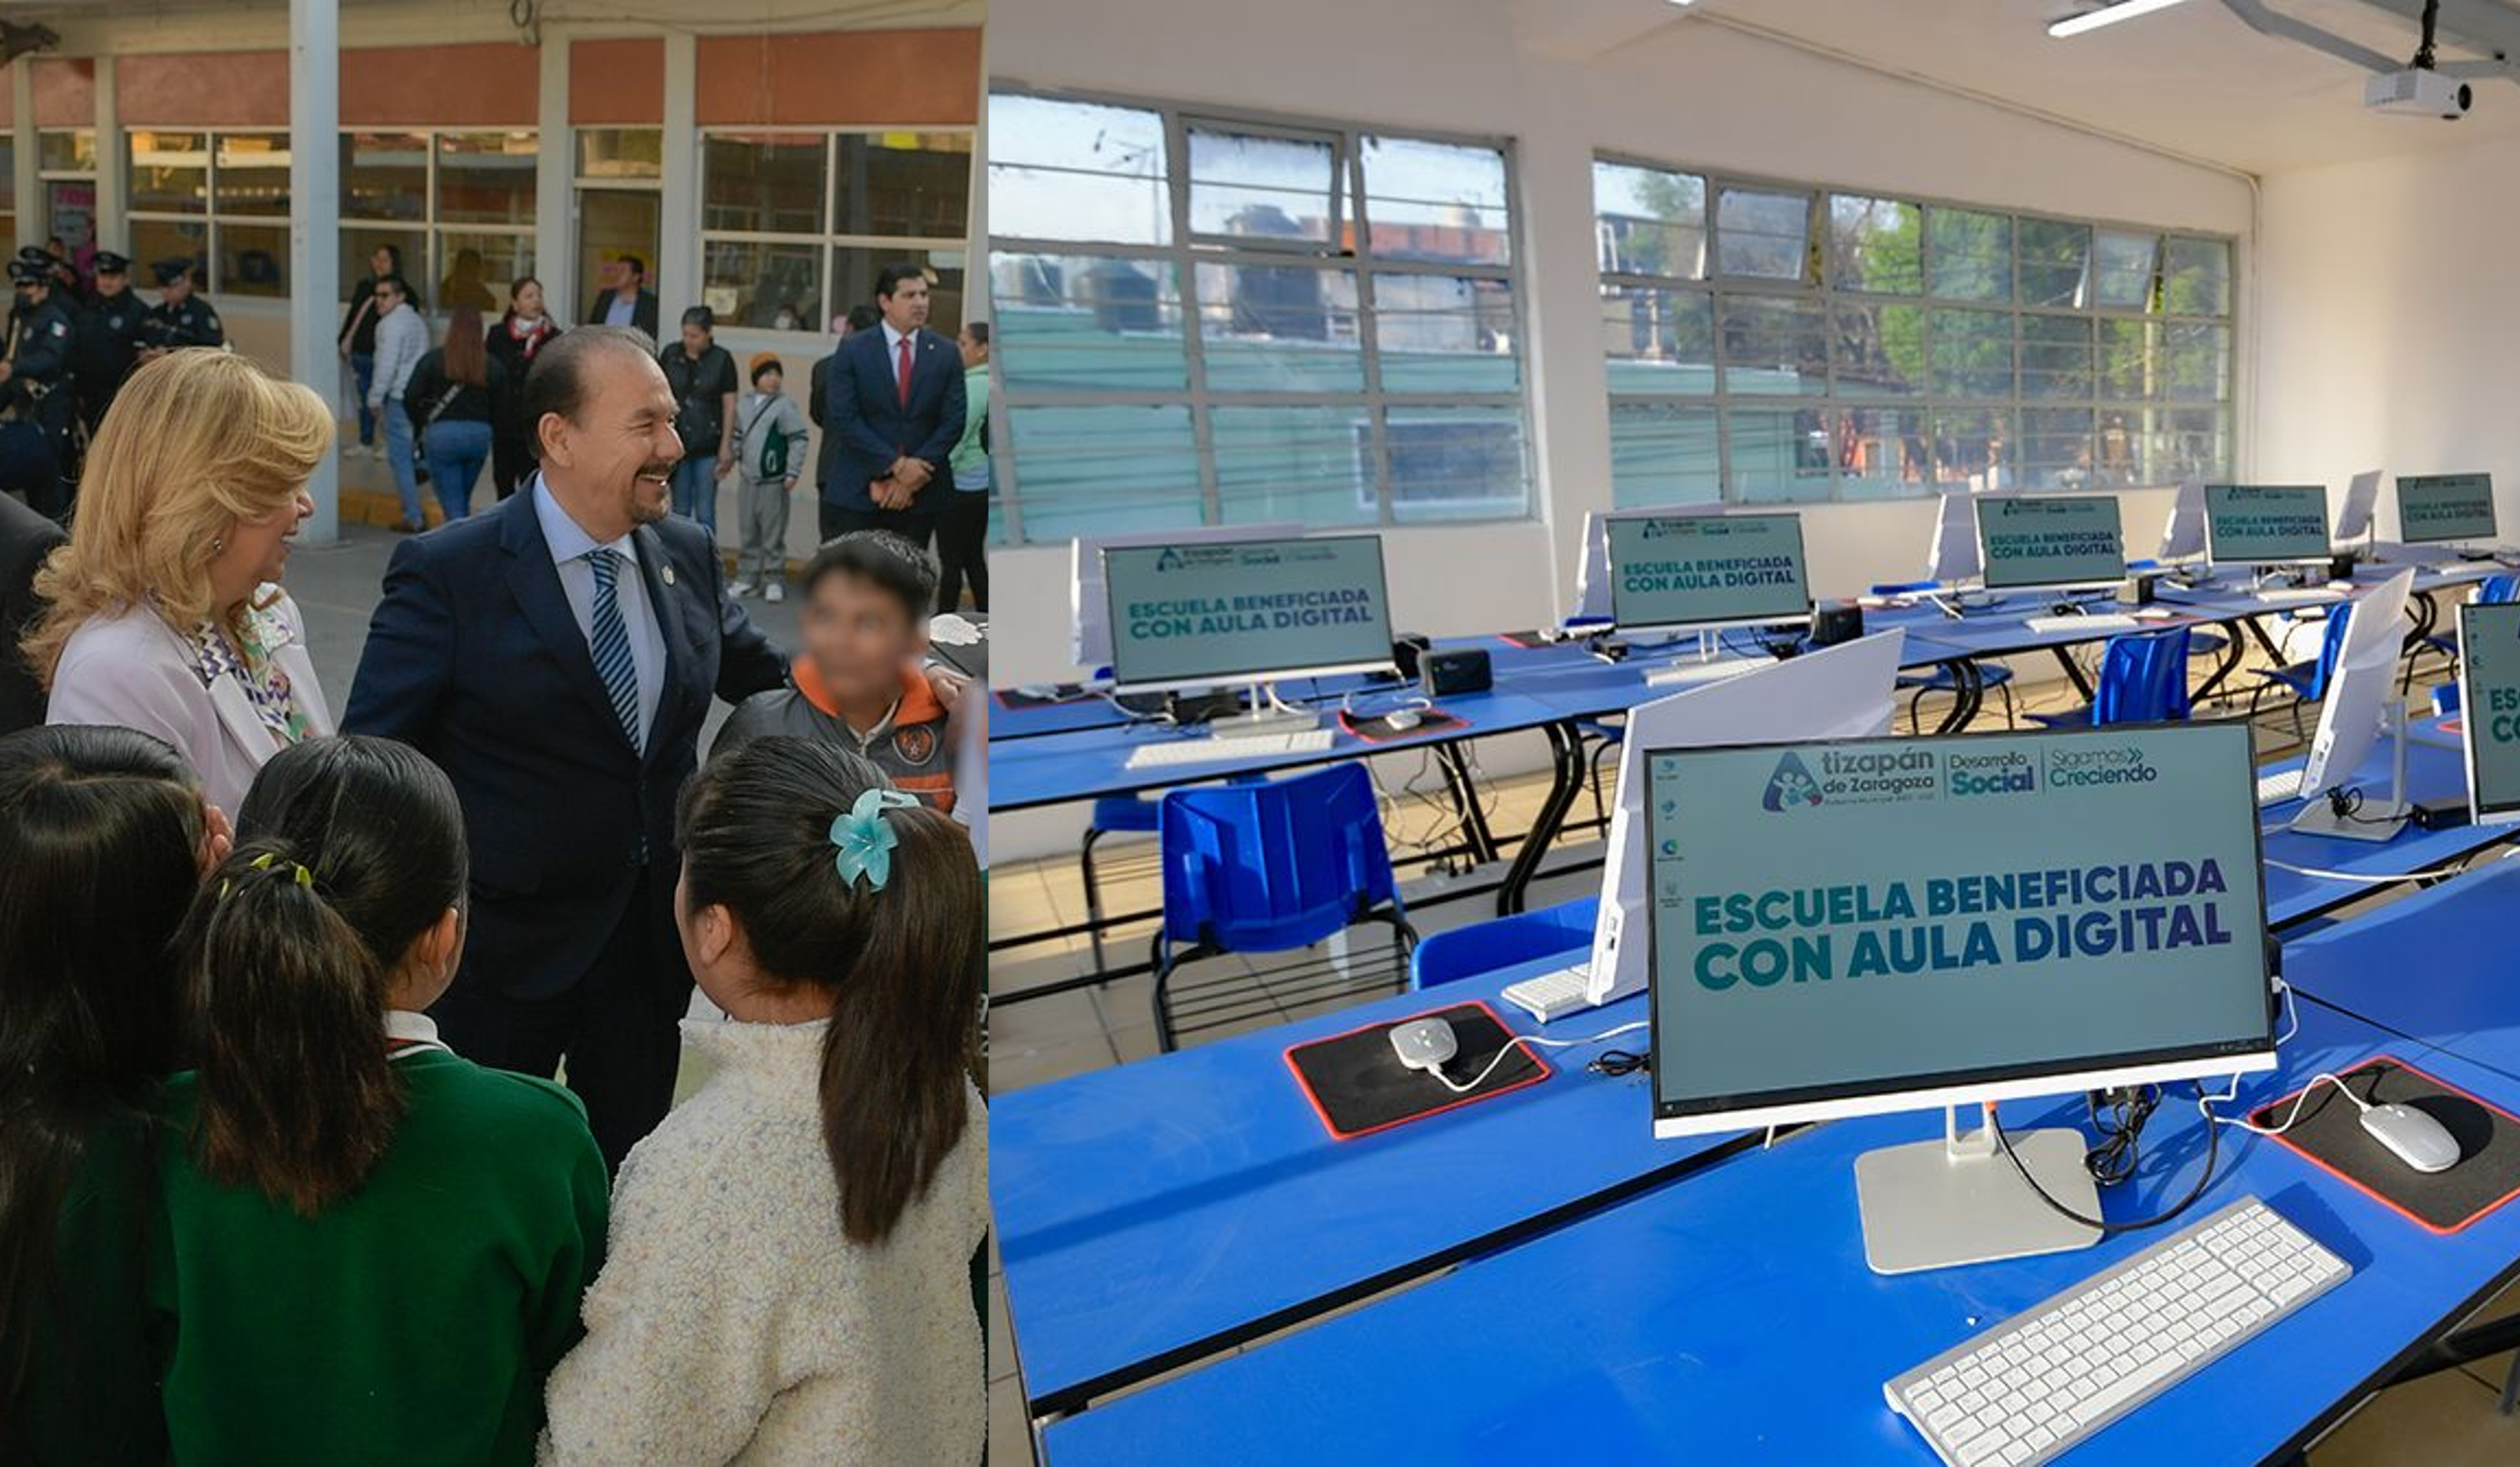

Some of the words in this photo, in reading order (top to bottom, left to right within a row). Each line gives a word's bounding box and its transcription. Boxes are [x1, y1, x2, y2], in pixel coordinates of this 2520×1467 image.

[1991, 545, 2023, 559] CON
[2027, 544, 2062, 558] AULA
[2064, 542, 2115, 556] DIGITAL
[1624, 561, 1692, 576] ESCUELA
[1697, 556, 1793, 572] BENEFICIADA
[1625, 576, 1670, 593] CON
[1673, 573, 1722, 591] AULA
[1726, 569, 1795, 587] DIGITAL
[1128, 597, 1228, 618] ESCUELA
[1234, 588, 1371, 612] BENEFICIADA
[1130, 618, 1192, 640] CON
[1199, 612, 1268, 635] AULA
[1274, 605, 1374, 628] DIGITAL
[2491, 688, 2520, 712] ES
[1822, 745, 1934, 777] tizapán
[2050, 762, 2157, 787] Creciendo
[1823, 778, 1847, 794] de
[1850, 775, 1934, 794] Zaragoza
[1952, 765, 2035, 795] Social
[1694, 882, 1916, 935] ESCUELA
[1926, 858, 2227, 916] BENEFICIADA
[1694, 935, 1832, 992] CON
[1848, 921, 2002, 979] AULA
[2015, 902, 2232, 963] DIGITAL
